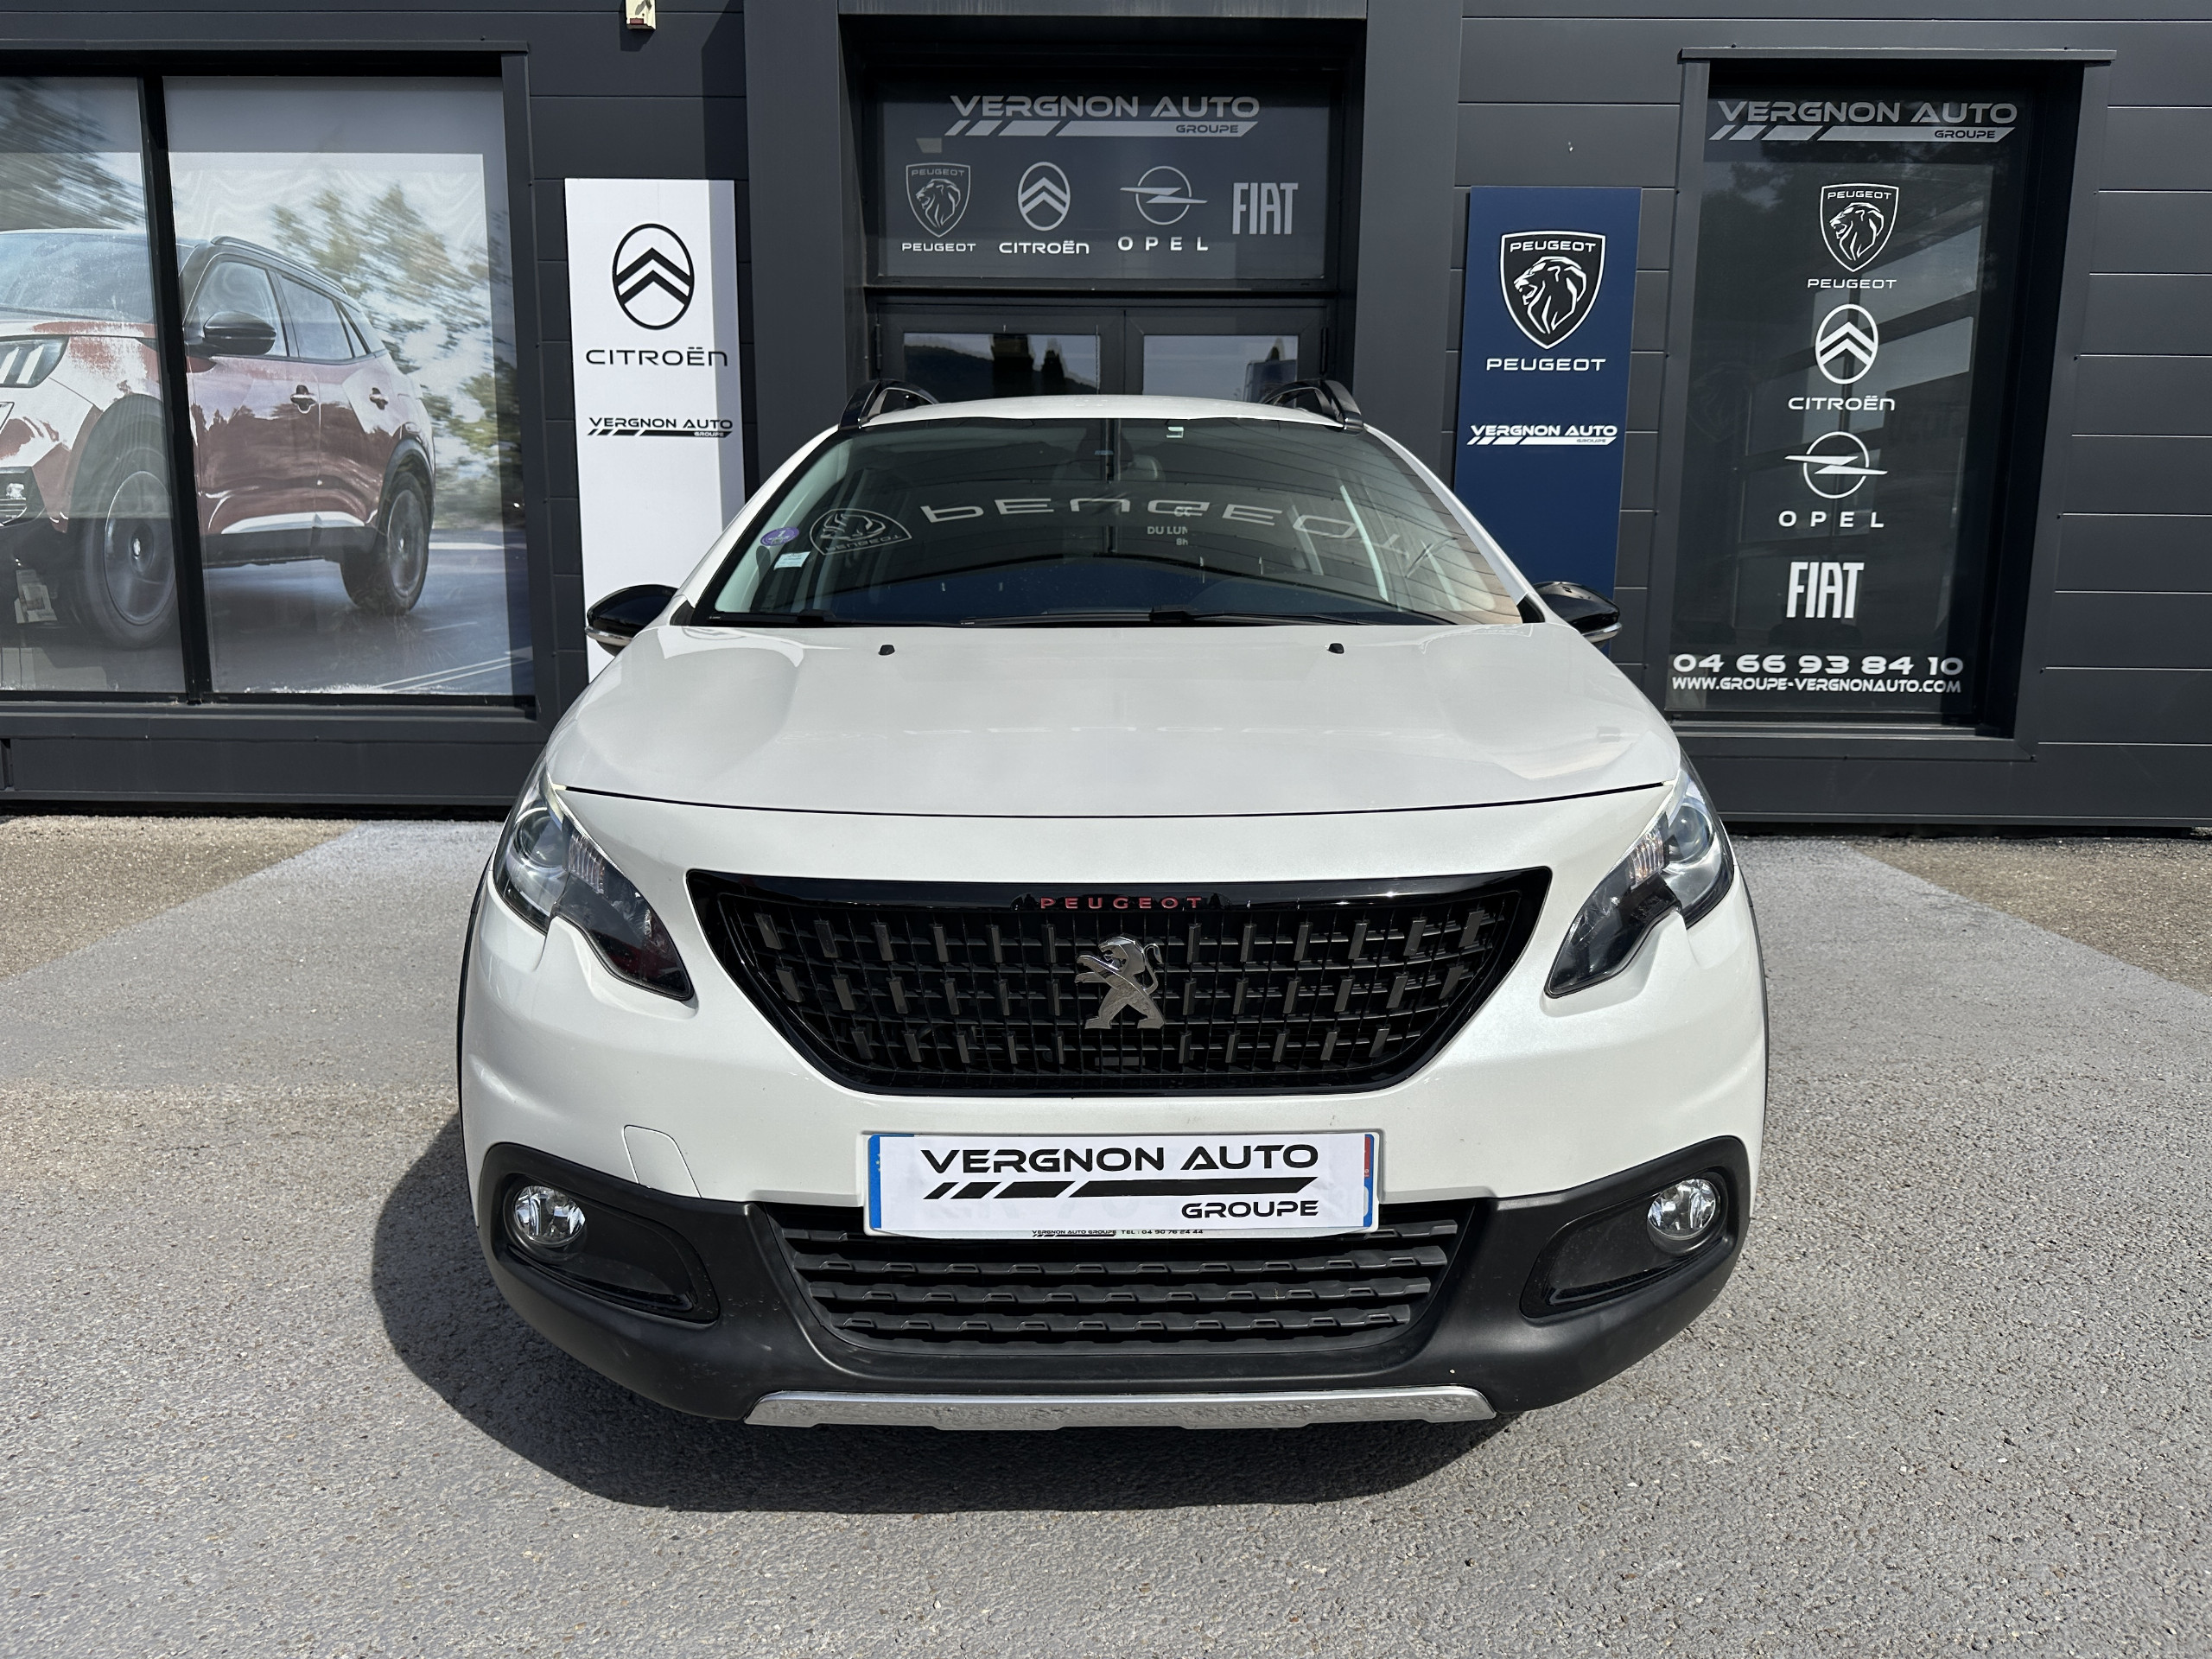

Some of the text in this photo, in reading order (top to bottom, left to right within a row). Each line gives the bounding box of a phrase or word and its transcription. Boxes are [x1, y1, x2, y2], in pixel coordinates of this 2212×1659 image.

[950, 95, 1260, 118] VERGNON AUTO
[1717, 100, 2018, 124] VERGNON AUTO
[1176, 124, 1239, 134] GROUPE
[1935, 130, 1996, 139] GROUPE
[912, 168, 965, 178] PEUGEOT
[1827, 190, 1892, 200] PEUGEOT
[1232, 182, 1298, 235] FIAT
[902, 242, 976, 252] PEUGEOT
[1510, 240, 1597, 253] PEUGEOT
[1807, 278, 1897, 289] PEUGEOT
[1486, 358, 1606, 372] PEUGEOT
[588, 417, 734, 429] VERGNON AUTO
[1471, 424, 1618, 436] VERGNON AUTO
[1147, 525, 1165, 535] DU
[1786, 562, 1865, 619] FIAT
[1672, 653, 1964, 676] 04 66 93 84 10
[1672, 677, 1961, 693] WWW.GROUPE-VERGNONAUTO.COM
[1040, 897, 1202, 909] PEUGEOT
[921, 1143, 1319, 1173] VERGNON AUTO
[1181, 1199, 1319, 1219] GROUPE
